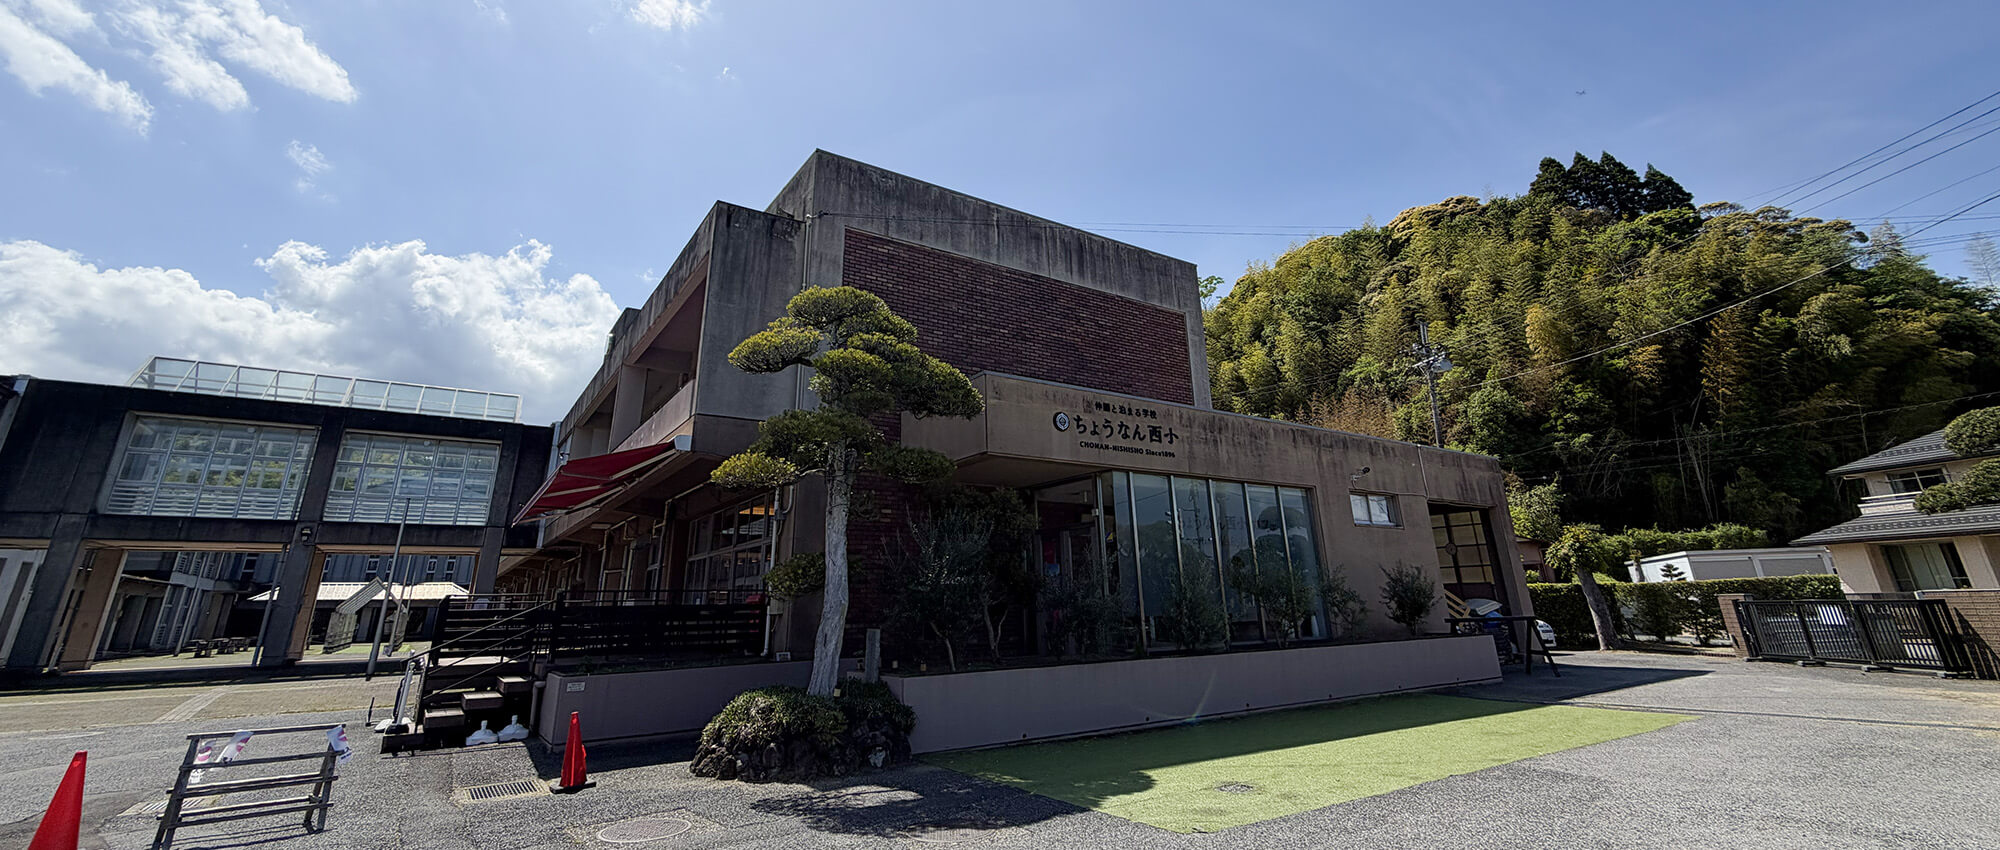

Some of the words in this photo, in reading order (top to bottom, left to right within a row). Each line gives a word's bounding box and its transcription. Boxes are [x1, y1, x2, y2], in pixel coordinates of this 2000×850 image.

[1073, 414, 1179, 445] ちょうなん西小
[1079, 441, 1144, 455] CHONAN-NISHISHO
